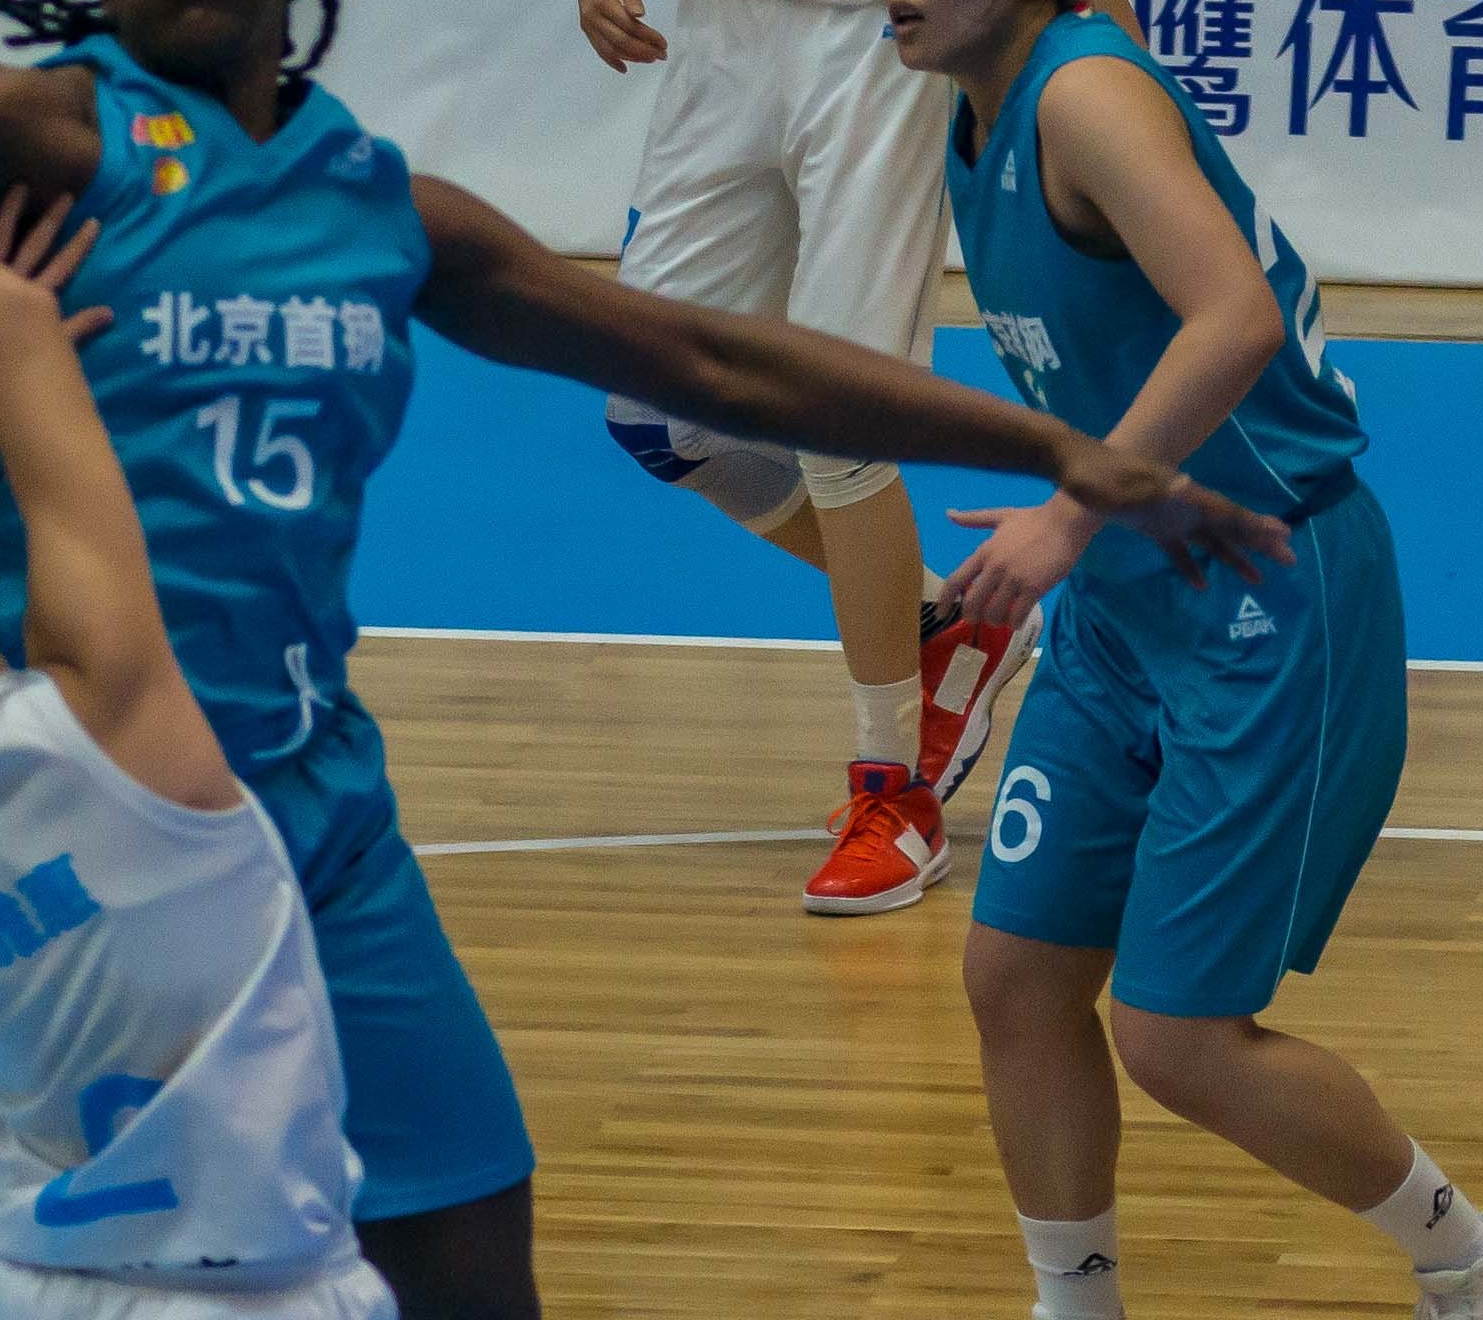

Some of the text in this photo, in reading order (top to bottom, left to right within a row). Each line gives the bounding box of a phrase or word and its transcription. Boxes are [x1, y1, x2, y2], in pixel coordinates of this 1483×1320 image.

[140, 291, 384, 375] 北京首钢
[196, 395, 323, 511] 15
